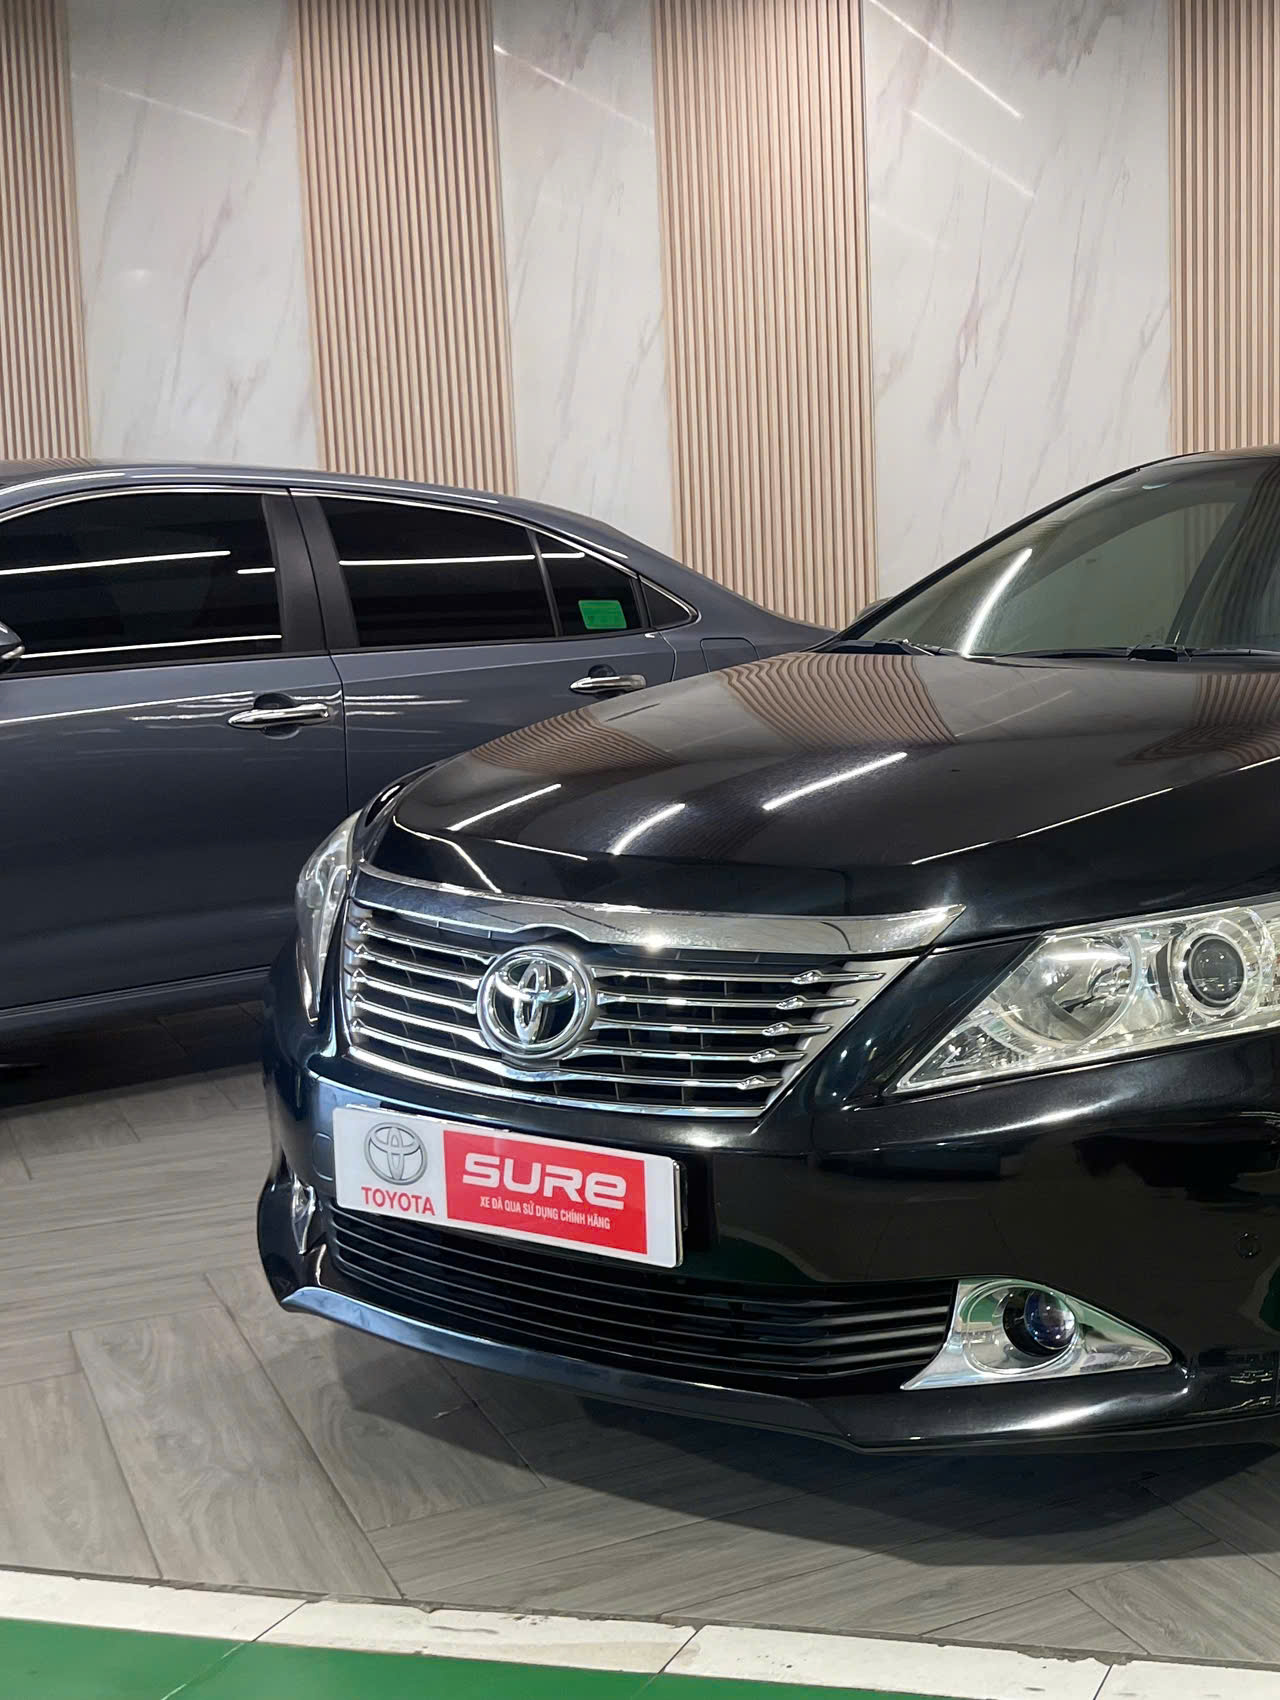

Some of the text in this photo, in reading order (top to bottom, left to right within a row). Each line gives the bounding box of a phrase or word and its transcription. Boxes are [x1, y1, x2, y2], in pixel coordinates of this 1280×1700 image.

[361, 1186, 436, 1216] TOYOTA
[479, 1195, 490, 1208] XE
[504, 1199, 521, 1214] QUA
[535, 1205, 559, 1221] DỤNG
[560, 1208, 586, 1225] CHÍNH
